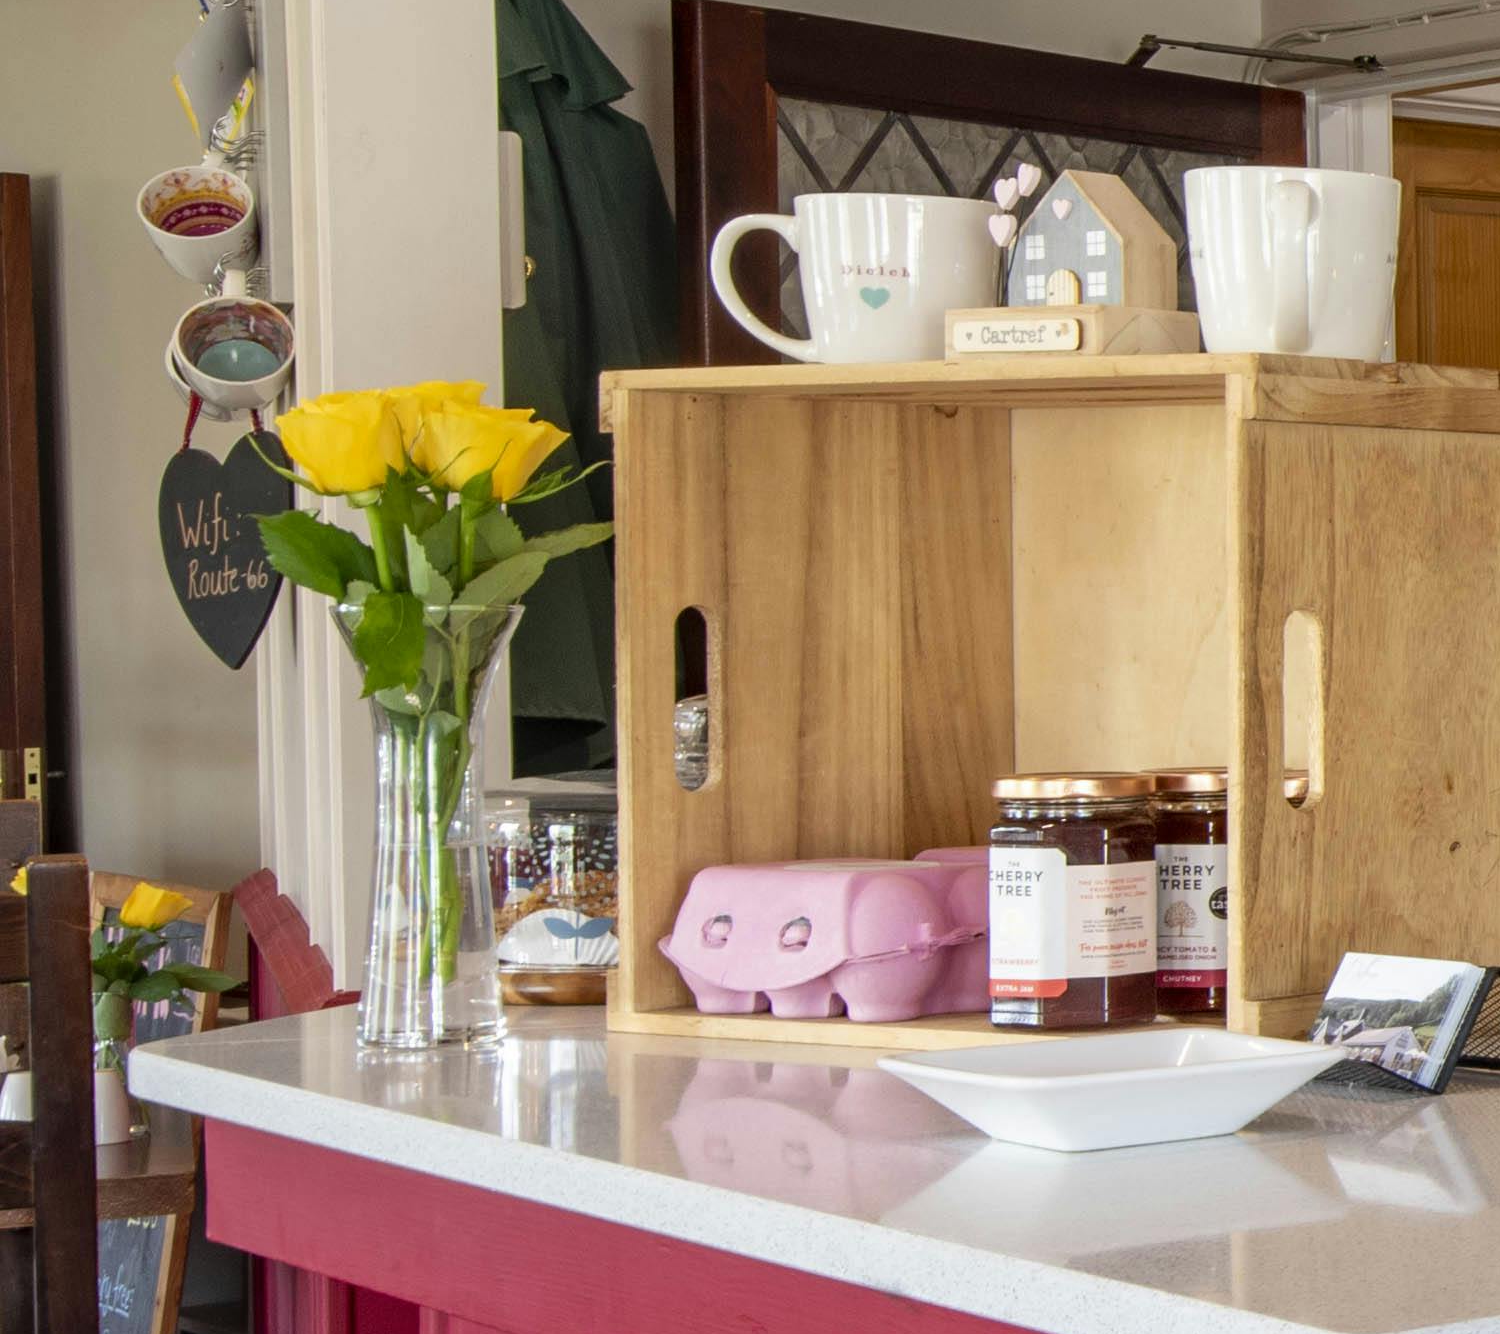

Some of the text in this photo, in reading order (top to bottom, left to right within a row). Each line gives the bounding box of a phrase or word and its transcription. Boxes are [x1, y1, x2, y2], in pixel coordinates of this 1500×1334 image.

[981, 325, 1046, 344] Cartref
[177, 492, 240, 555] Wifi:
[188, 555, 268, 600] Route-66
[1160, 866, 1214, 876] HERRY
[1160, 879, 1202, 890] TREE
[997, 885, 1032, 896] TREE
[1163, 975, 1202, 983] CHUTNEY
